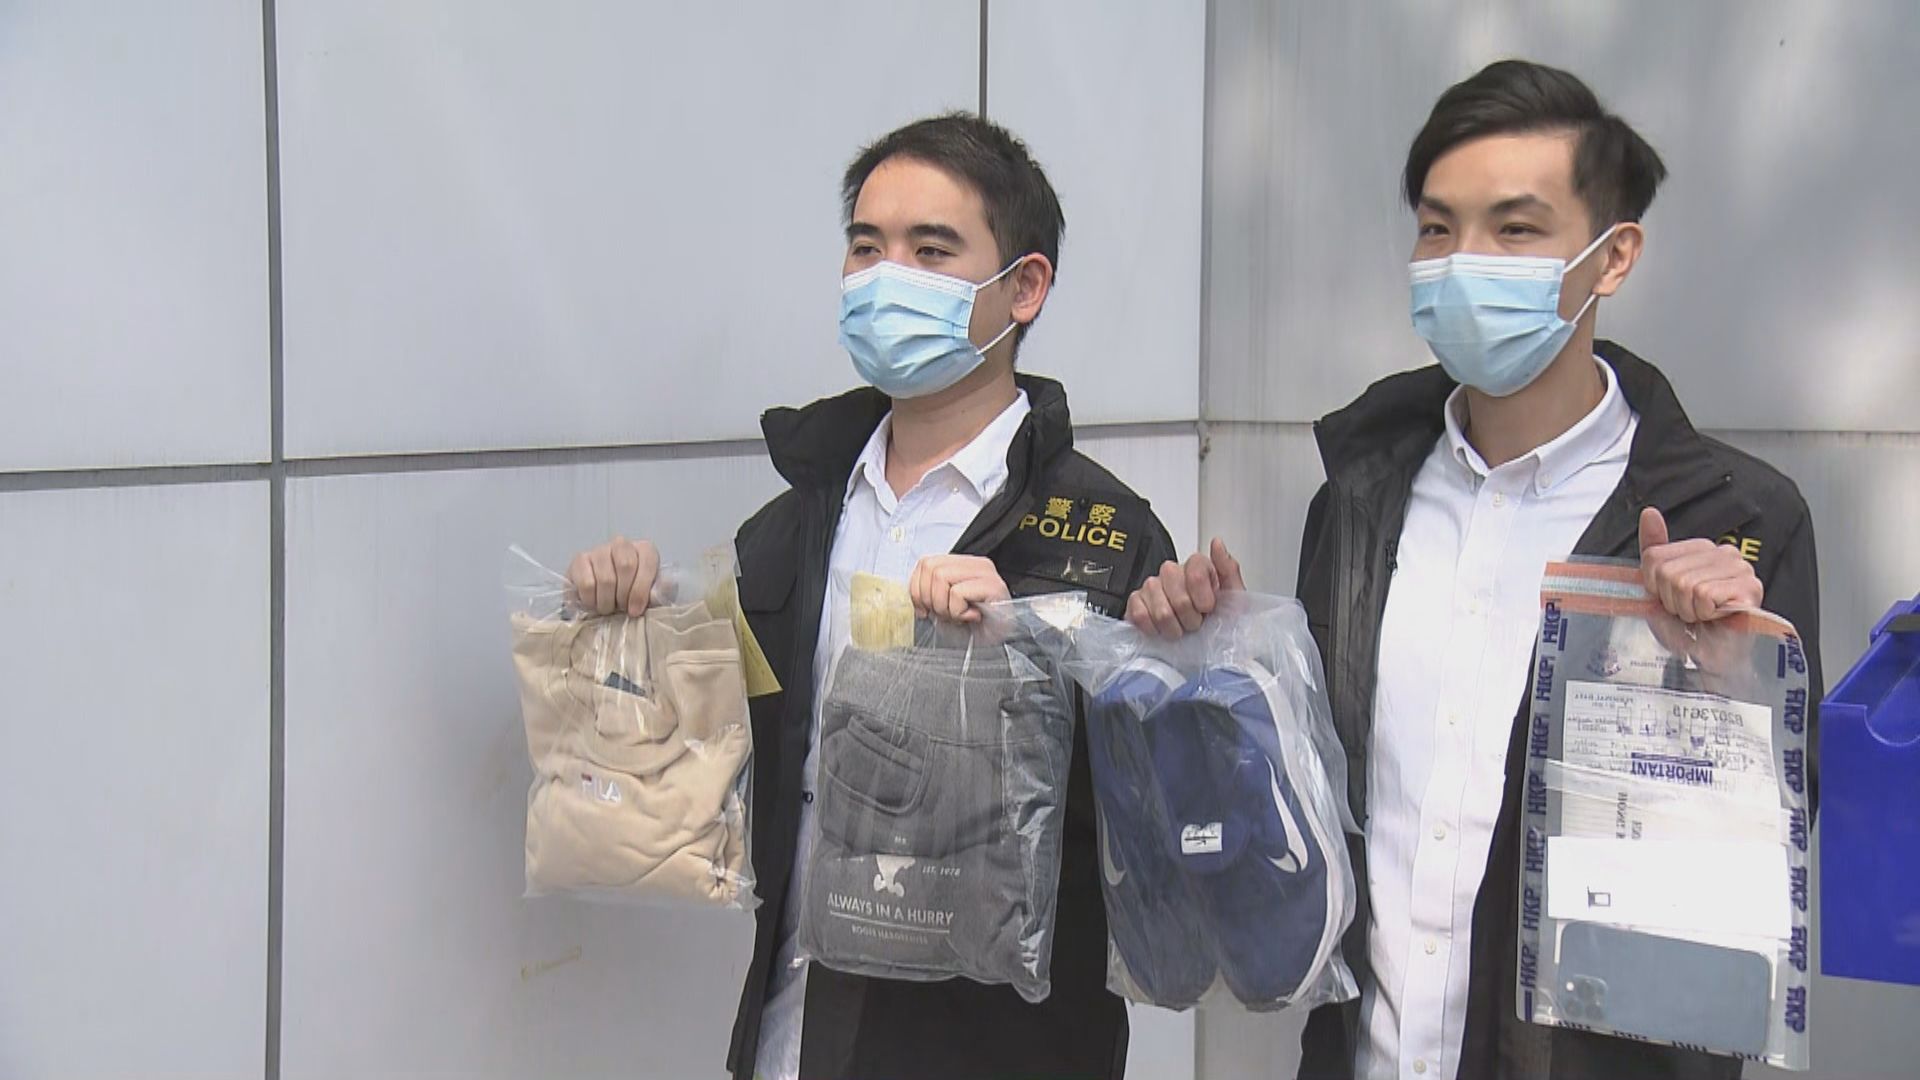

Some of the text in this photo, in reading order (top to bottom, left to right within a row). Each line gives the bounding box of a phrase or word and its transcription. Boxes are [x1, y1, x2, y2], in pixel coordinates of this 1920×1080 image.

[1019, 514, 1128, 551] POLICE
[1542, 600, 1561, 643] HKP
[1536, 655, 1554, 701] HKP
[1530, 713, 1550, 759] HKP
[1528, 772, 1547, 816] HKP
[1630, 760, 1713, 785] IMPORTANT
[1525, 826, 1545, 873] HKP
[827, 892, 954, 926] ALWAYS IN A HURRY
[1523, 886, 1541, 931] HKP
[1520, 944, 1537, 989] HKP
